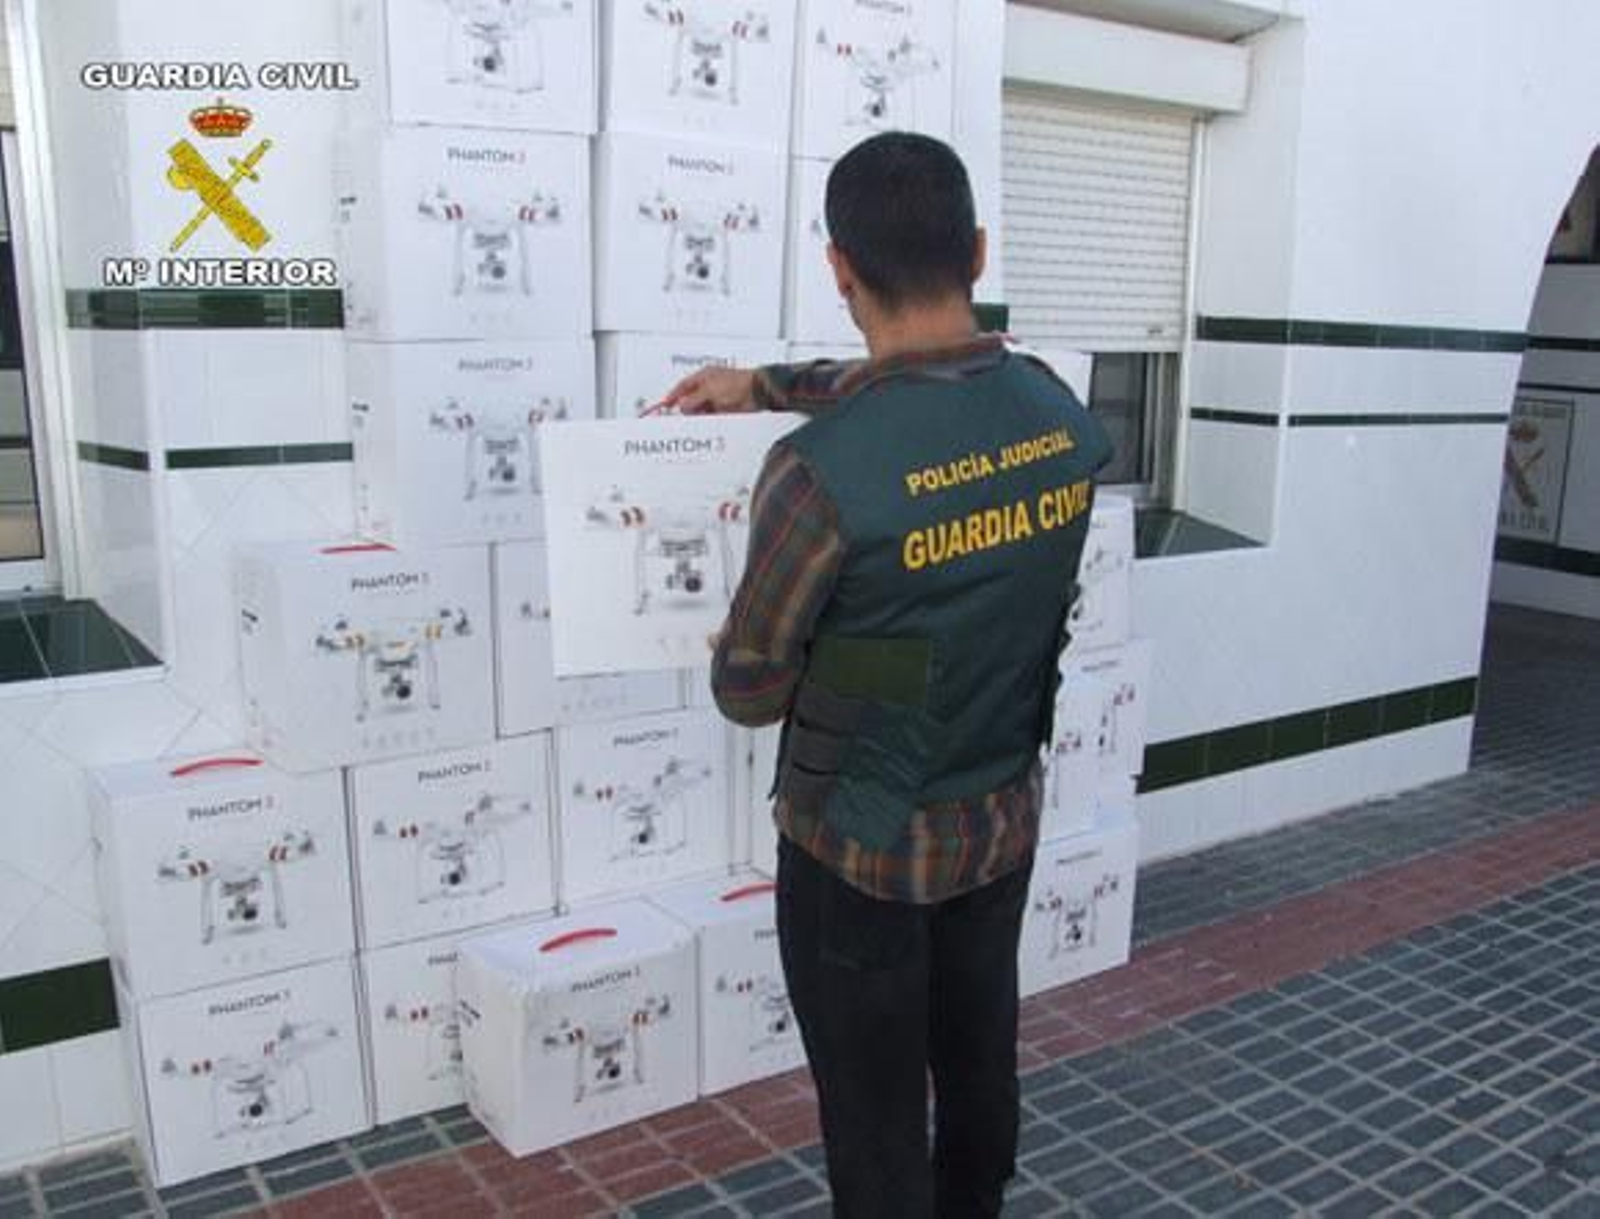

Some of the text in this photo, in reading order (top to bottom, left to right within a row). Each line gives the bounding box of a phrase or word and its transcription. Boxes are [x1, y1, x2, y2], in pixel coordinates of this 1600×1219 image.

[624, 437, 712, 455] PHANTOM
[903, 501, 1034, 570] GUARDIA
[351, 573, 420, 593] PHANTOM
[418, 762, 482, 783] PHANTOM
[187, 799, 262, 821] PHANTOM
[208, 992, 281, 1015] PHANTOM
